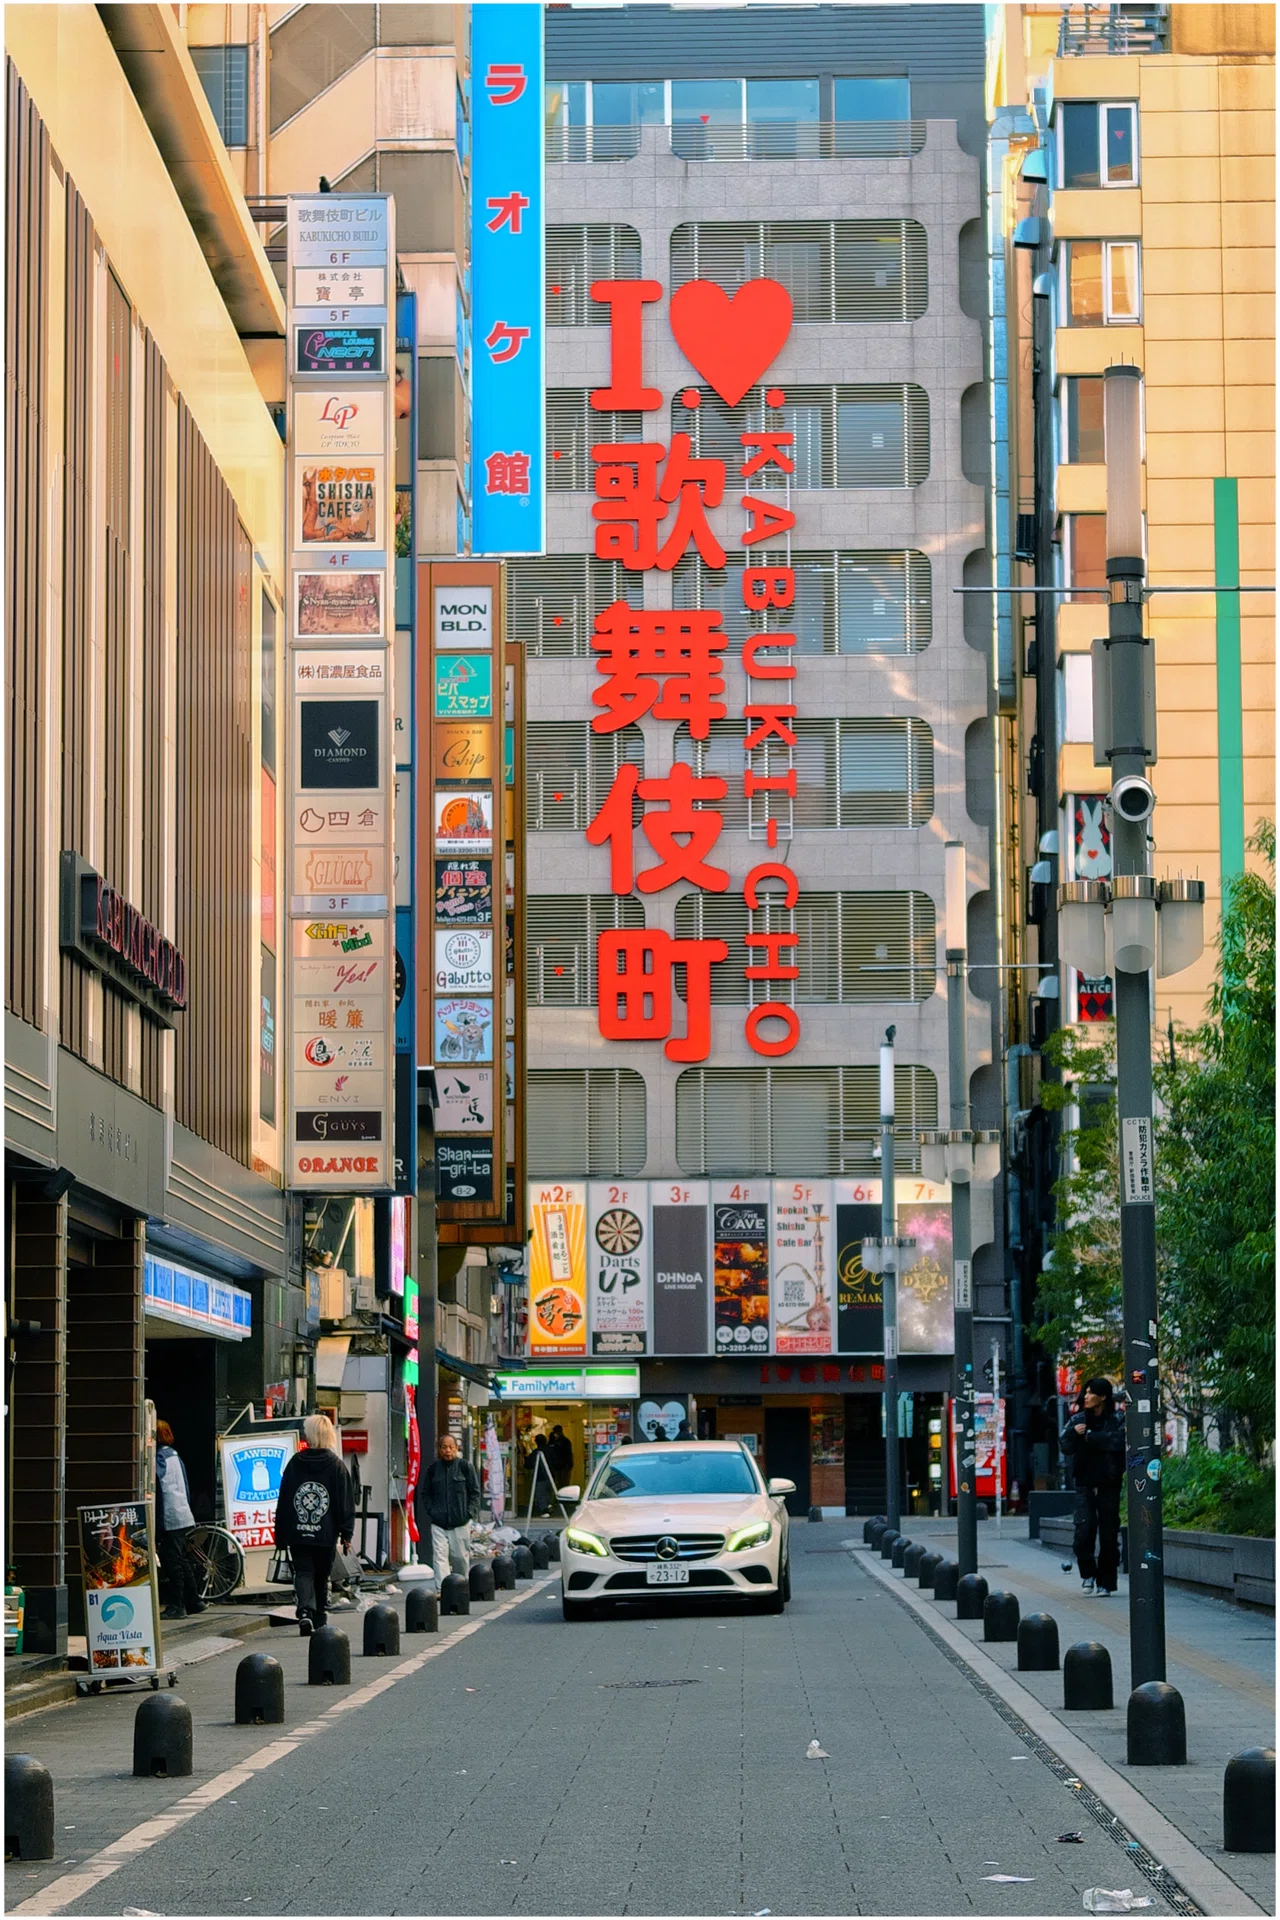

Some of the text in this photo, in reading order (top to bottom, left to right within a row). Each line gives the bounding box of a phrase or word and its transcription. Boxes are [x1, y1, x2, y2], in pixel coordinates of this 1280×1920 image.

[298, 209, 383, 222] 歌舞伎町ビル
[300, 231, 379, 242] KABUKICHO BUILD
[318, 272, 362, 281] 株式会社
[591, 279, 663, 412] I
[317, 467, 375, 482] 水タバコ
[318, 484, 374, 499] SHISHA
[318, 501, 352, 518] CAFE
[441, 604, 488, 615] MON
[442, 621, 488, 631] BLD.
[448, 696, 490, 709] スマップ
[586, 432, 731, 1063] 歌舞伎町
[741, 432, 801, 1058] KABUKI-CHO
[314, 748, 367, 757] DIAMOND
[447, 862, 479, 871] 隠れ家
[441, 870, 487, 886] 個室
[436, 885, 491, 899] ダイニング
[477, 912, 492, 922] 3F
[479, 931, 492, 940] 2F
[333, 962, 378, 992] Yes!
[436, 970, 492, 989] Gabutto
[1079, 984, 1111, 993] ALICE
[479, 1073, 489, 1081] B1
[331, 1122, 366, 1131] GUYS
[438, 1147, 472, 1161] Shan
[1138, 1125, 1150, 1193] 防犯カメラ作動中
[298, 1157, 379, 1173] ORANGE
[456, 1187, 472, 1195] B-2
[540, 1186, 572, 1203] M2F
[608, 1186, 628, 1203] 2F
[670, 1186, 690, 1203] 3F
[730, 1184, 750, 1201] 4F
[793, 1184, 812, 1201] 5F
[853, 1184, 873, 1201] 6F
[914, 1184, 935, 1200] 7F
[777, 1206, 808, 1214] Hookah
[716, 1207, 766, 1230] CAVE
[777, 1222, 805, 1231] Shisha
[777, 1238, 813, 1247] Cafe Bar
[600, 1255, 640, 1268] Darts
[599, 1269, 641, 1294] UP
[657, 1272, 703, 1283] DHNoA
[840, 1293, 884, 1304] RE:MAK
[511, 1380, 576, 1393] FamilyMart
[235, 1449, 282, 1463] LAWSON
[233, 1529, 276, 1546] 銀行A
[89, 1594, 99, 1606] B1
[97, 1630, 143, 1643] Aqua Vista
